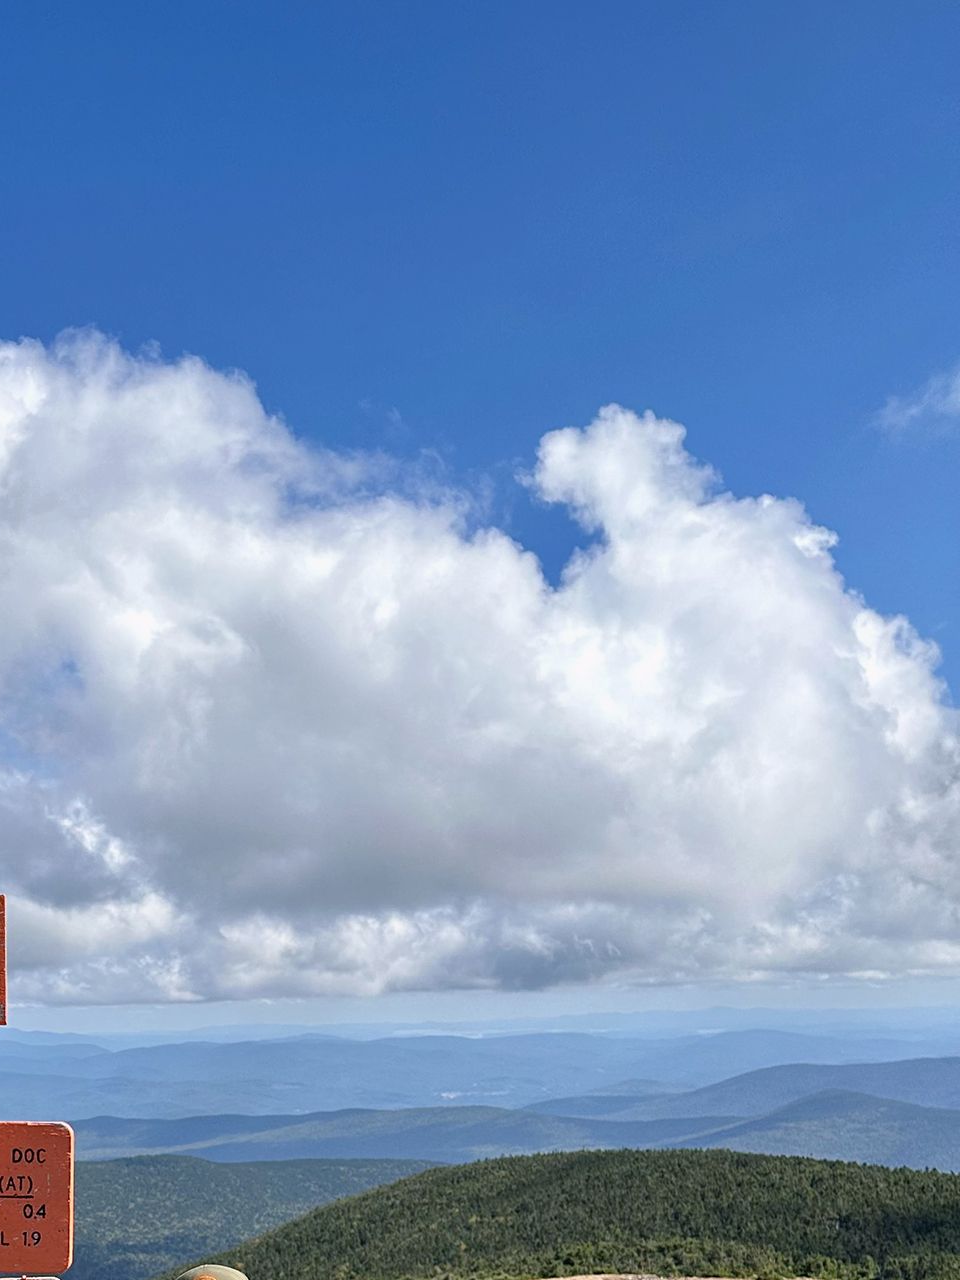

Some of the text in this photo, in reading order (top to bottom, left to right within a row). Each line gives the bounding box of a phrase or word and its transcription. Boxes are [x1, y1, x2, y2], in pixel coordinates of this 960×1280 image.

[11, 1147, 47, 1164] DOC
[22, 1203, 46, 1219] 0.4
[22, 1231, 42, 1246] 1.9
